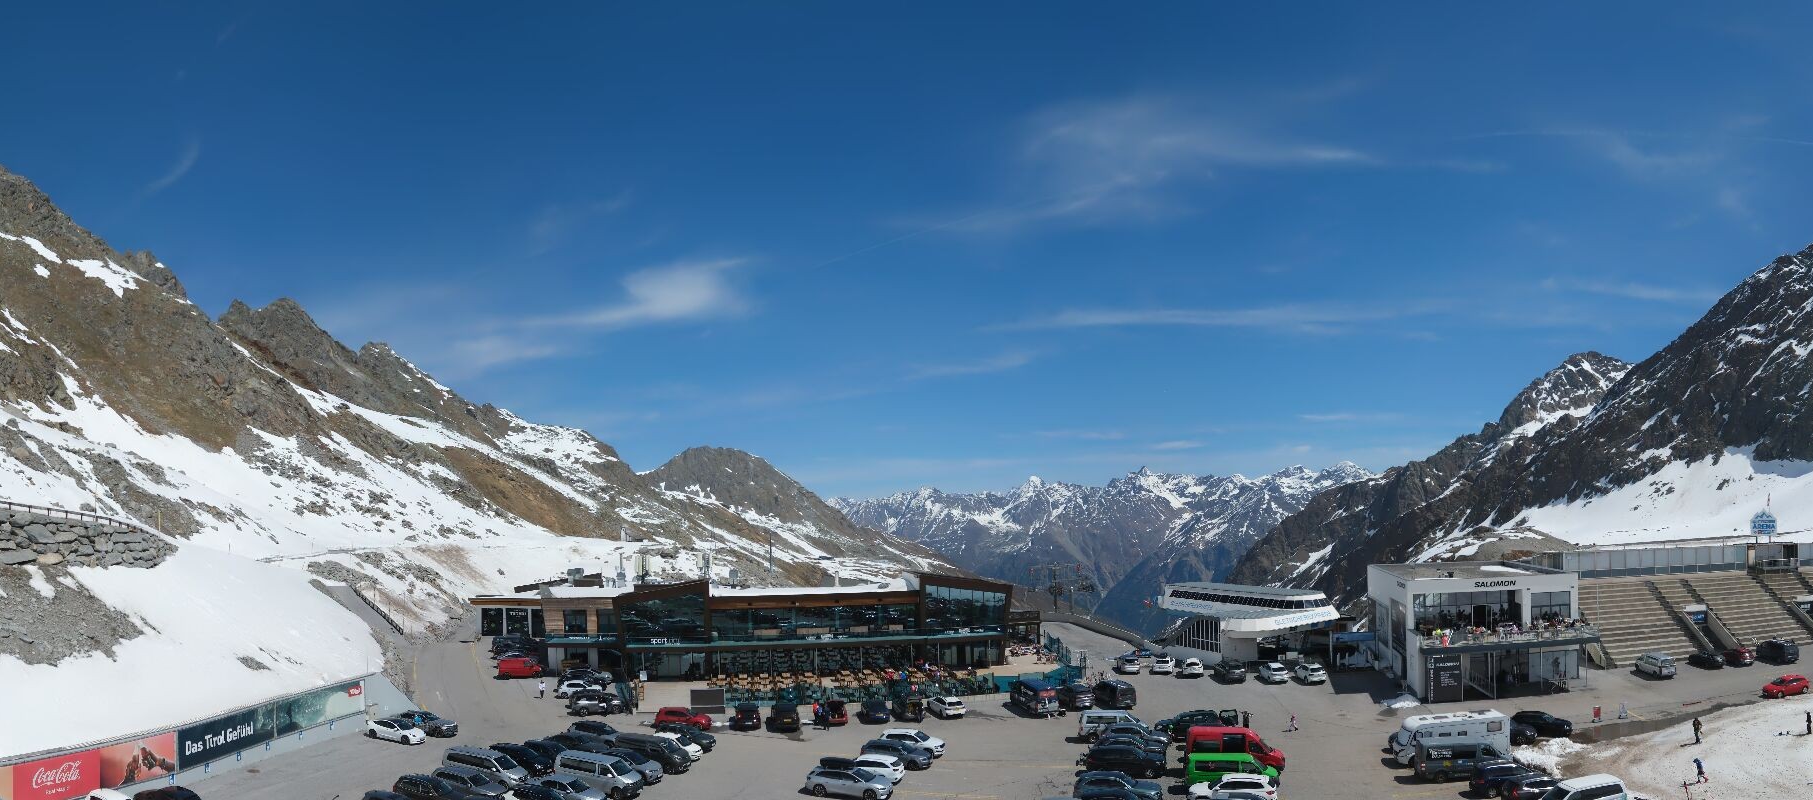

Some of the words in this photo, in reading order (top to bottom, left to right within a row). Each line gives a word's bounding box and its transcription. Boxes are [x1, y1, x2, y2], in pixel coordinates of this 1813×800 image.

[1474, 580, 1516, 588] SALOMON
[650, 637, 668, 645] sport
[185, 740, 204, 756] Das
[204, 730, 226, 750] Tirol
[226, 721, 254, 743] Gefühl
